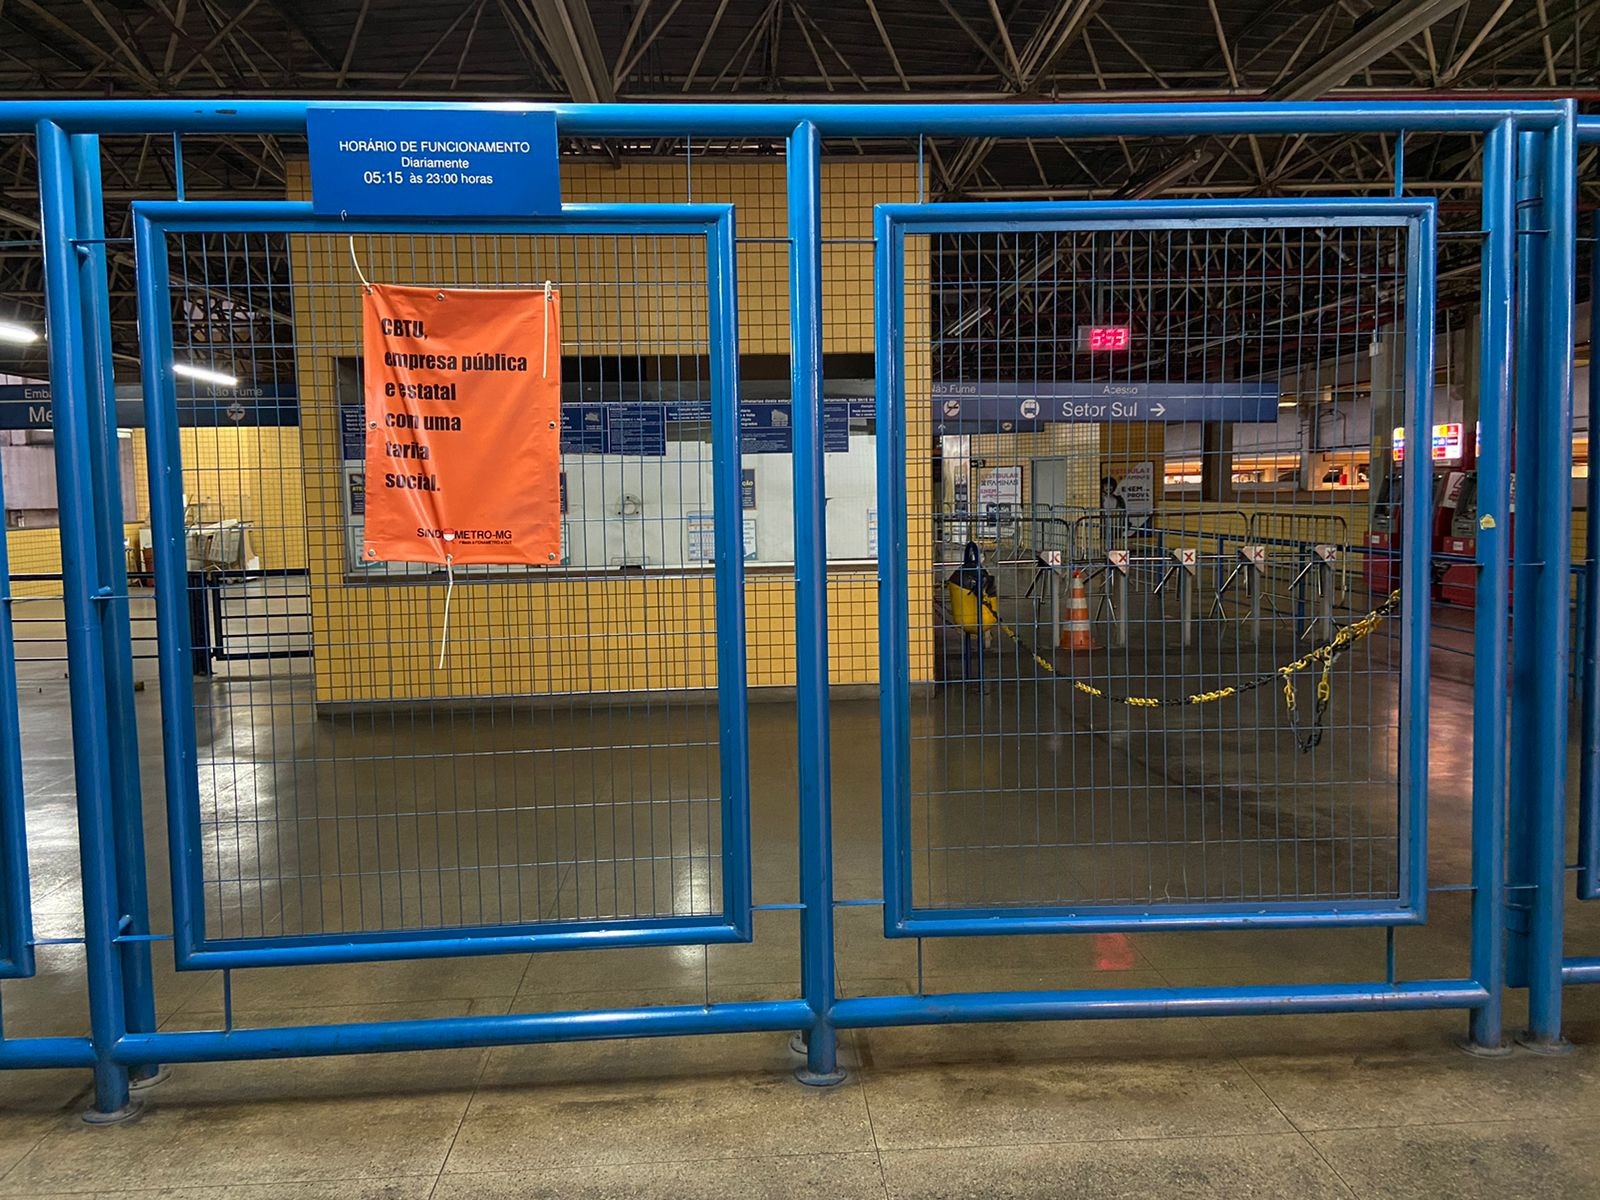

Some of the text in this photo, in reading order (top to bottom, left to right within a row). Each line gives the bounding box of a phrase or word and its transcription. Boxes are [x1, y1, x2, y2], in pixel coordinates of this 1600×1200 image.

[339, 138, 530, 153] HORÁRIO DE FUNCIONAMENTO
[401, 156, 469, 168] Diariamente
[364, 171, 493, 184] 05:15 às 23:00 horas
[381, 317, 428, 340] CBTU,
[385, 351, 527, 372] empresa pública
[385, 382, 456, 400] e estatal
[949, 384, 976, 394] Fume
[1103, 385, 1138, 395] Acesso
[1062, 401, 1138, 417] Setor Sul
[385, 413, 461, 431] com uma
[385, 472, 440, 491] social.
